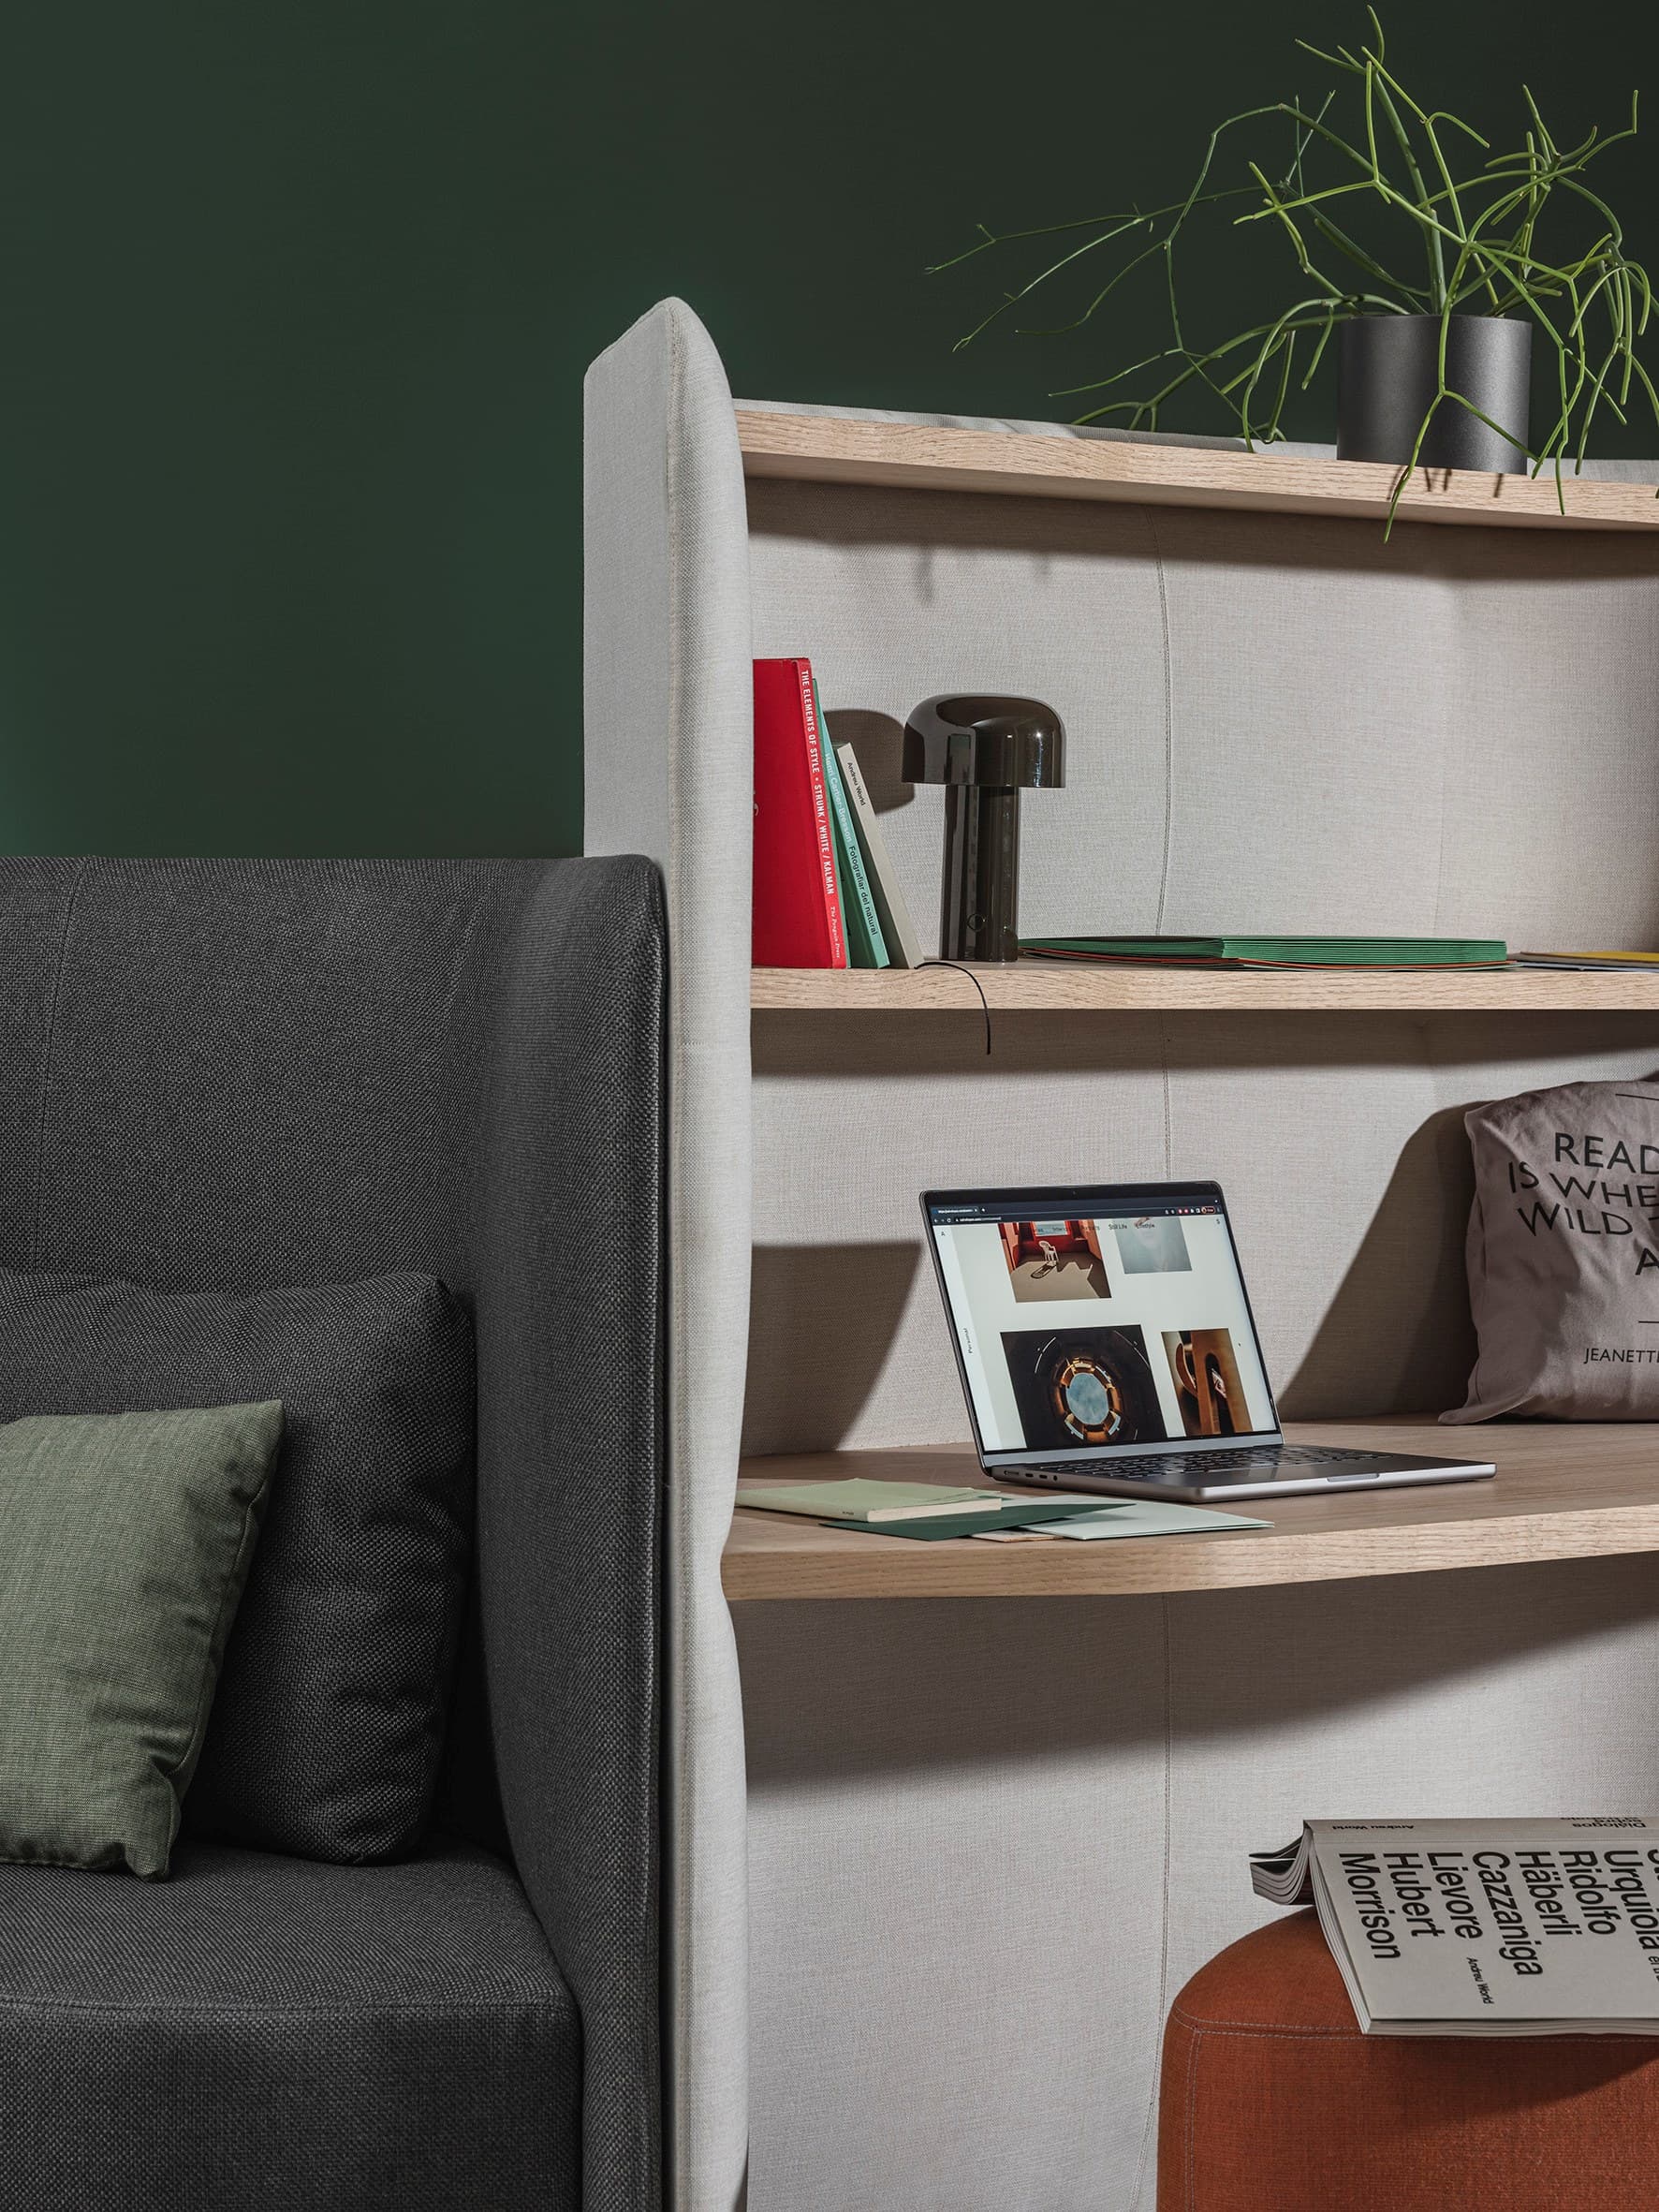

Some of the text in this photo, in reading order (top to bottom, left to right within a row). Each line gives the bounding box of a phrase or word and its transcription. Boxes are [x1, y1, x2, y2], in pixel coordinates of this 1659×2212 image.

[801, 670, 810, 686] THE
[803, 688, 815, 732] ELEMENTS
[808, 734, 816, 745] OF
[810, 748, 820, 774] STYLE
[815, 785, 825, 818] STRUNK
[825, 753, 853, 843] Henri Cartier-Bresson
[847, 762, 867, 806] Andreu World
[819, 825, 830, 852] WHITE
[824, 861, 834, 894] KALMAN
[849, 846, 878, 936] Fotografiar del natural
[1508, 1161, 1540, 1194] IS
[1517, 1202, 1634, 1237] WILD
[1583, 1348, 1659, 1364] JEANETT
[1339, 1853, 1401, 1958] Morrison
[1383, 1853, 1446, 1937] Hubert
[1427, 1852, 1483, 1939] Lievore
[1472, 1851, 1544, 1975] Cazzaniga
[1515, 1851, 1583, 1935] Häberli
[1558, 1851, 1622, 1935] Ridolfo
[1604, 1851, 1659, 1950] Urquiola
[1467, 1957, 1495, 2005] Andreu World
